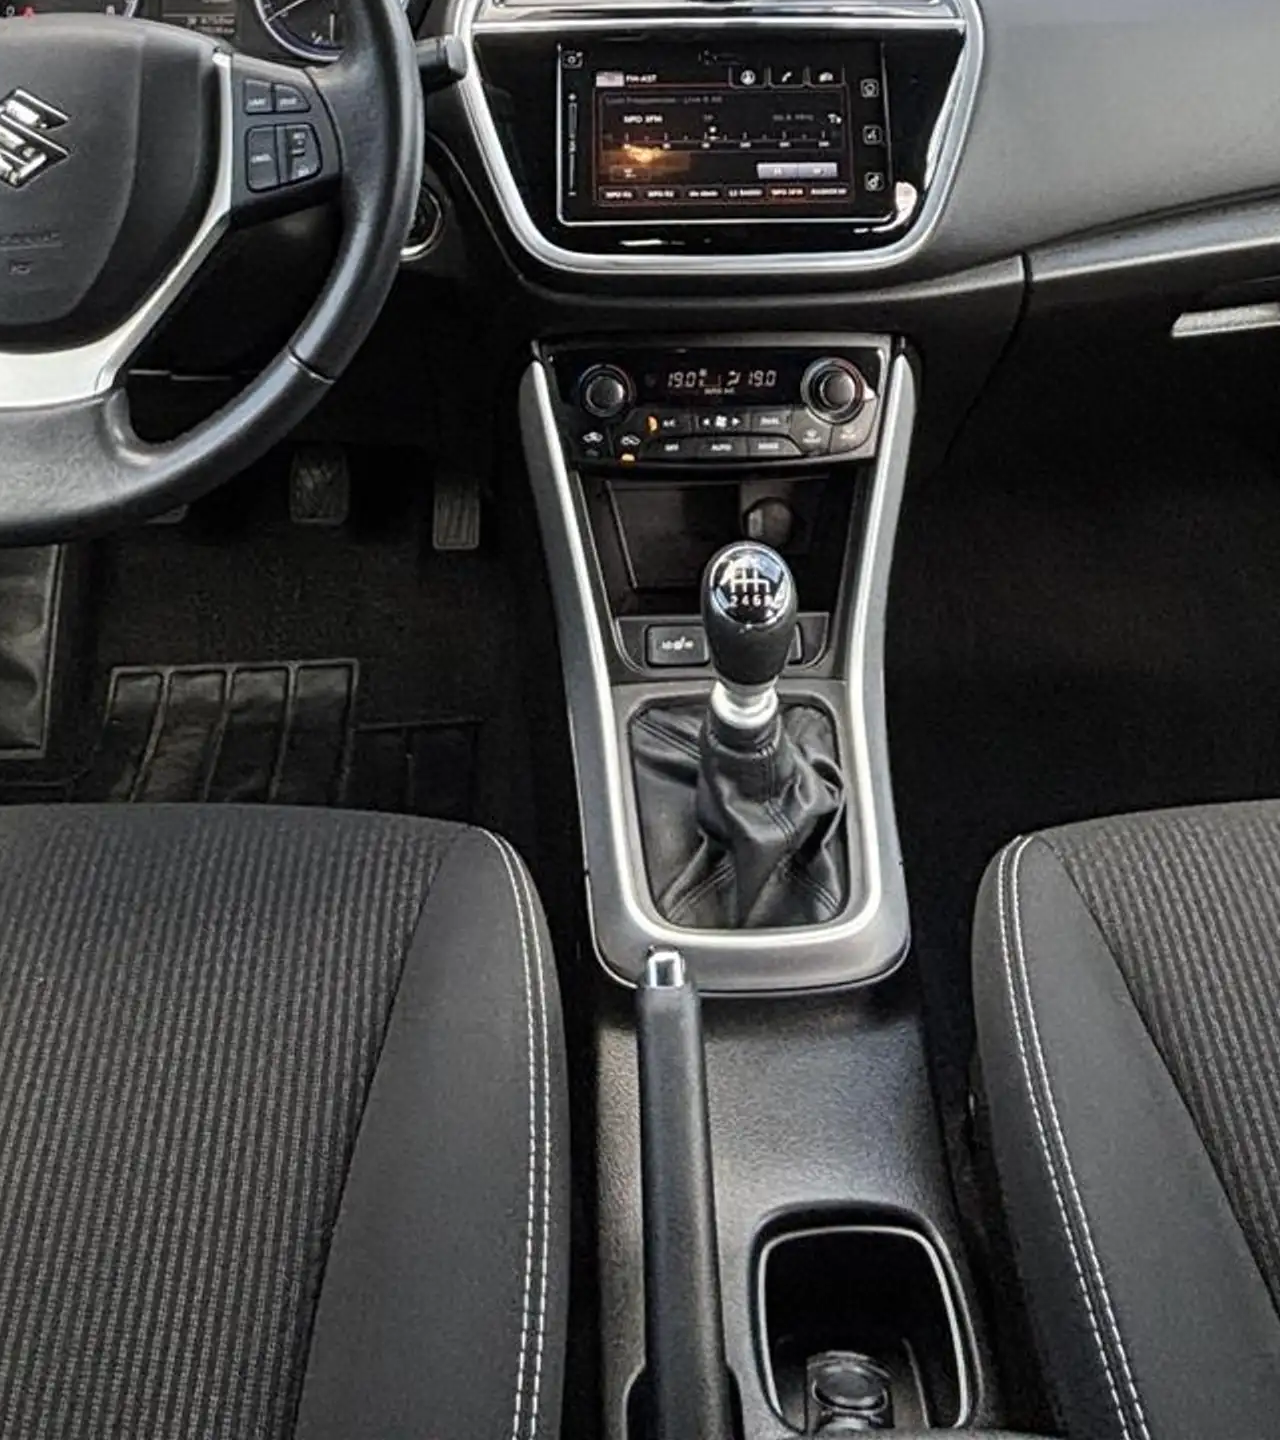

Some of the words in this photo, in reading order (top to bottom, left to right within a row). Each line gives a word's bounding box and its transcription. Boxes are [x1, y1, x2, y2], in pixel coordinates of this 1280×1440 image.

[666, 371, 697, 388] 19.0
[747, 369, 778, 387] 19.0
[729, 594, 738, 607] 2
[741, 594, 751, 607] 4
[752, 593, 762, 607] 6
